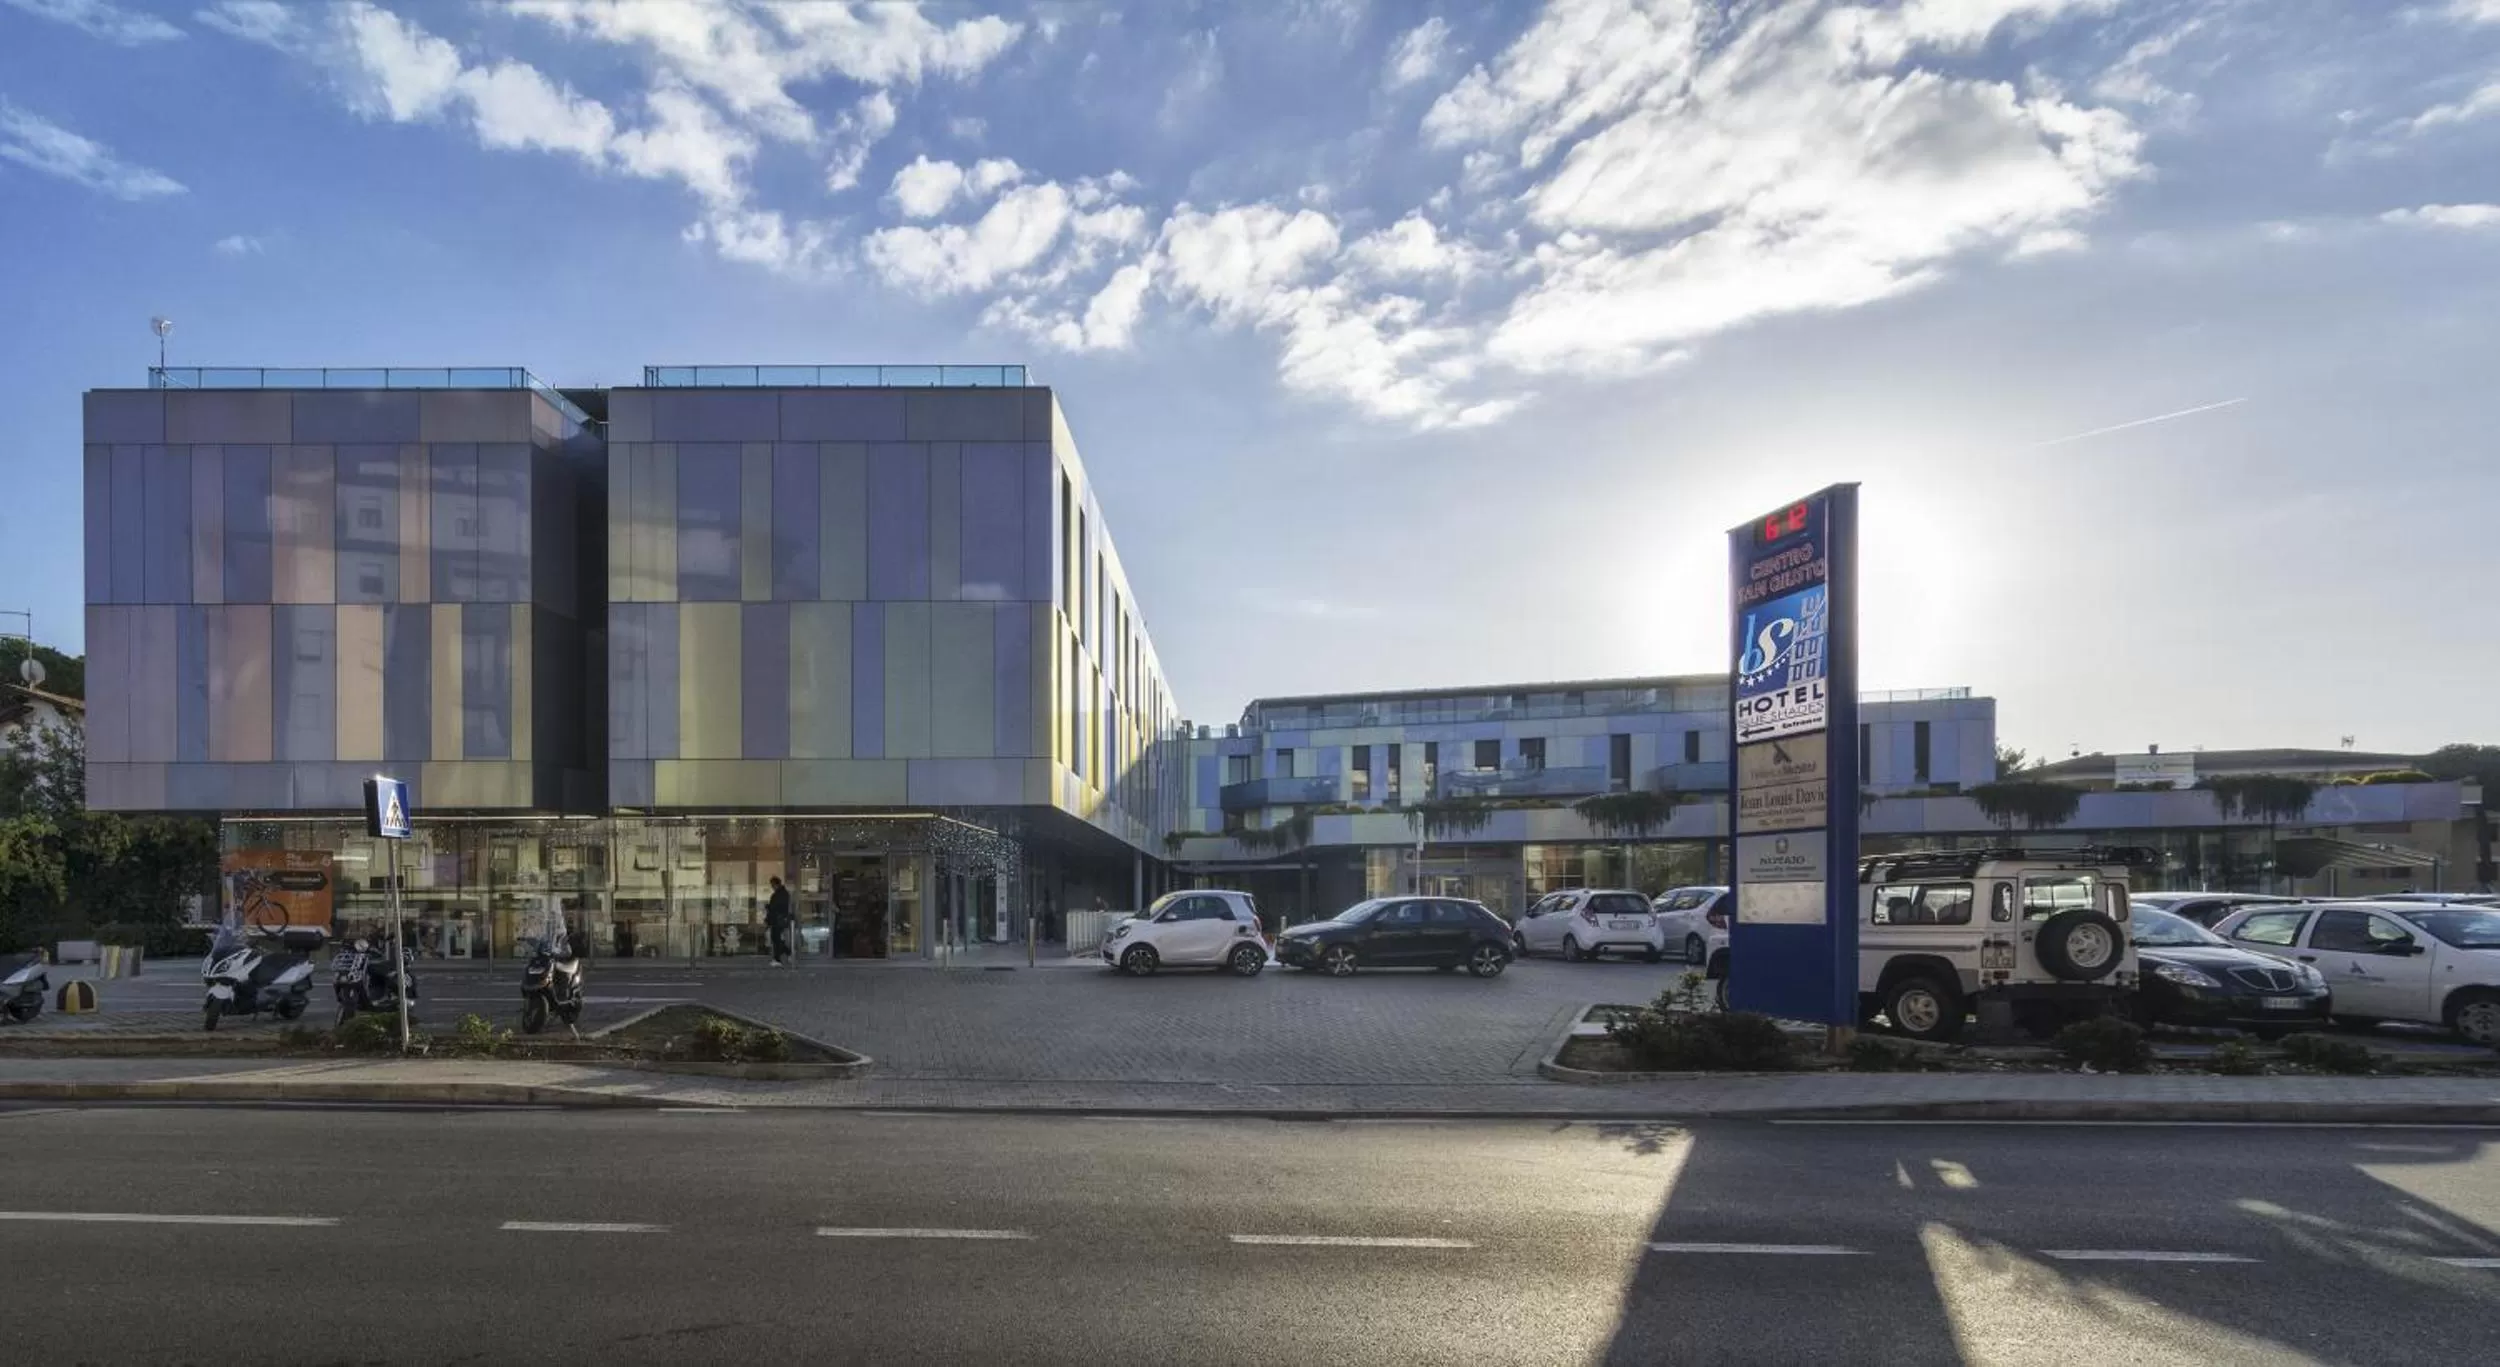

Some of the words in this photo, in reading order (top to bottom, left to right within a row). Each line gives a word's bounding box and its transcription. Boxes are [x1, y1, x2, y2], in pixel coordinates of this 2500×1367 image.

[1750, 542, 1813, 580] CENTRO
[1769, 556, 1826, 593] GIUSTO
[1739, 683, 1824, 718] HOTEL
[1771, 702, 1825, 722] SHADES
[1763, 787, 1794, 807] Louis
